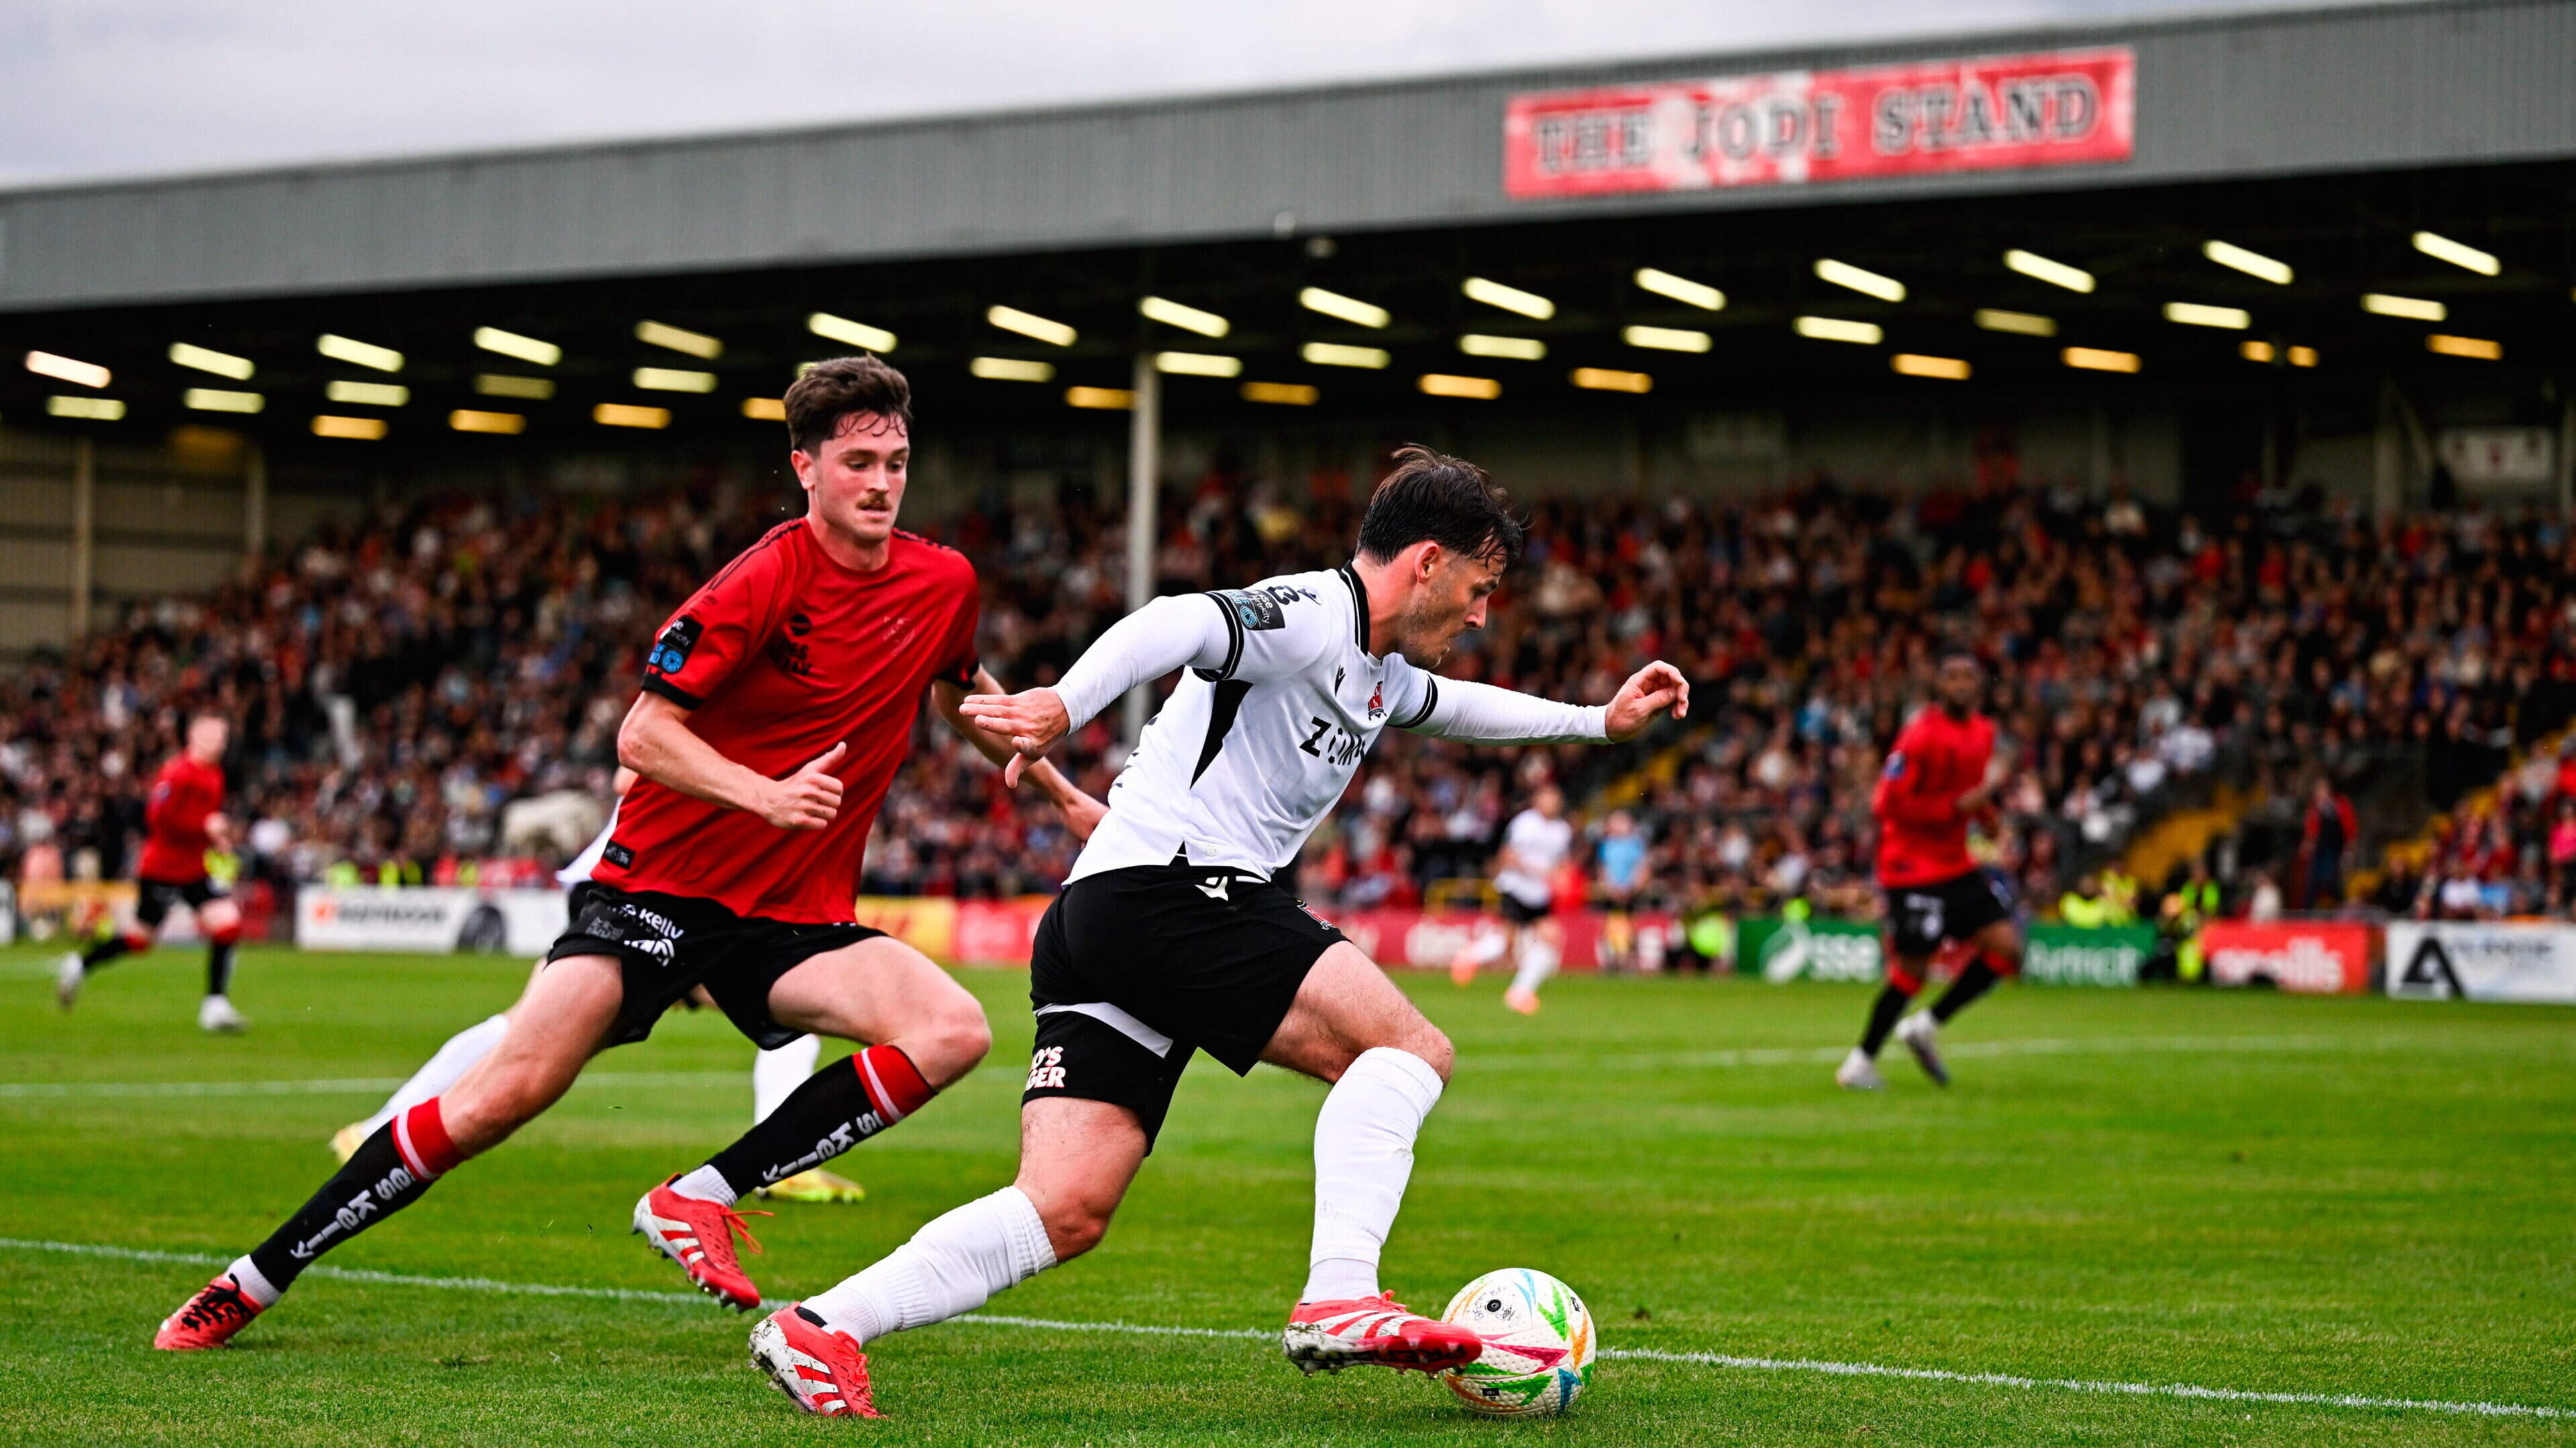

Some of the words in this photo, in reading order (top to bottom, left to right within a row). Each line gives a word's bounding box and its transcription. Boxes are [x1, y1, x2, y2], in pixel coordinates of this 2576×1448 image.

[1540, 109, 1651, 171] THE
[1686, 95, 1839, 160] JODI
[1876, 76, 2098, 152] STAND
